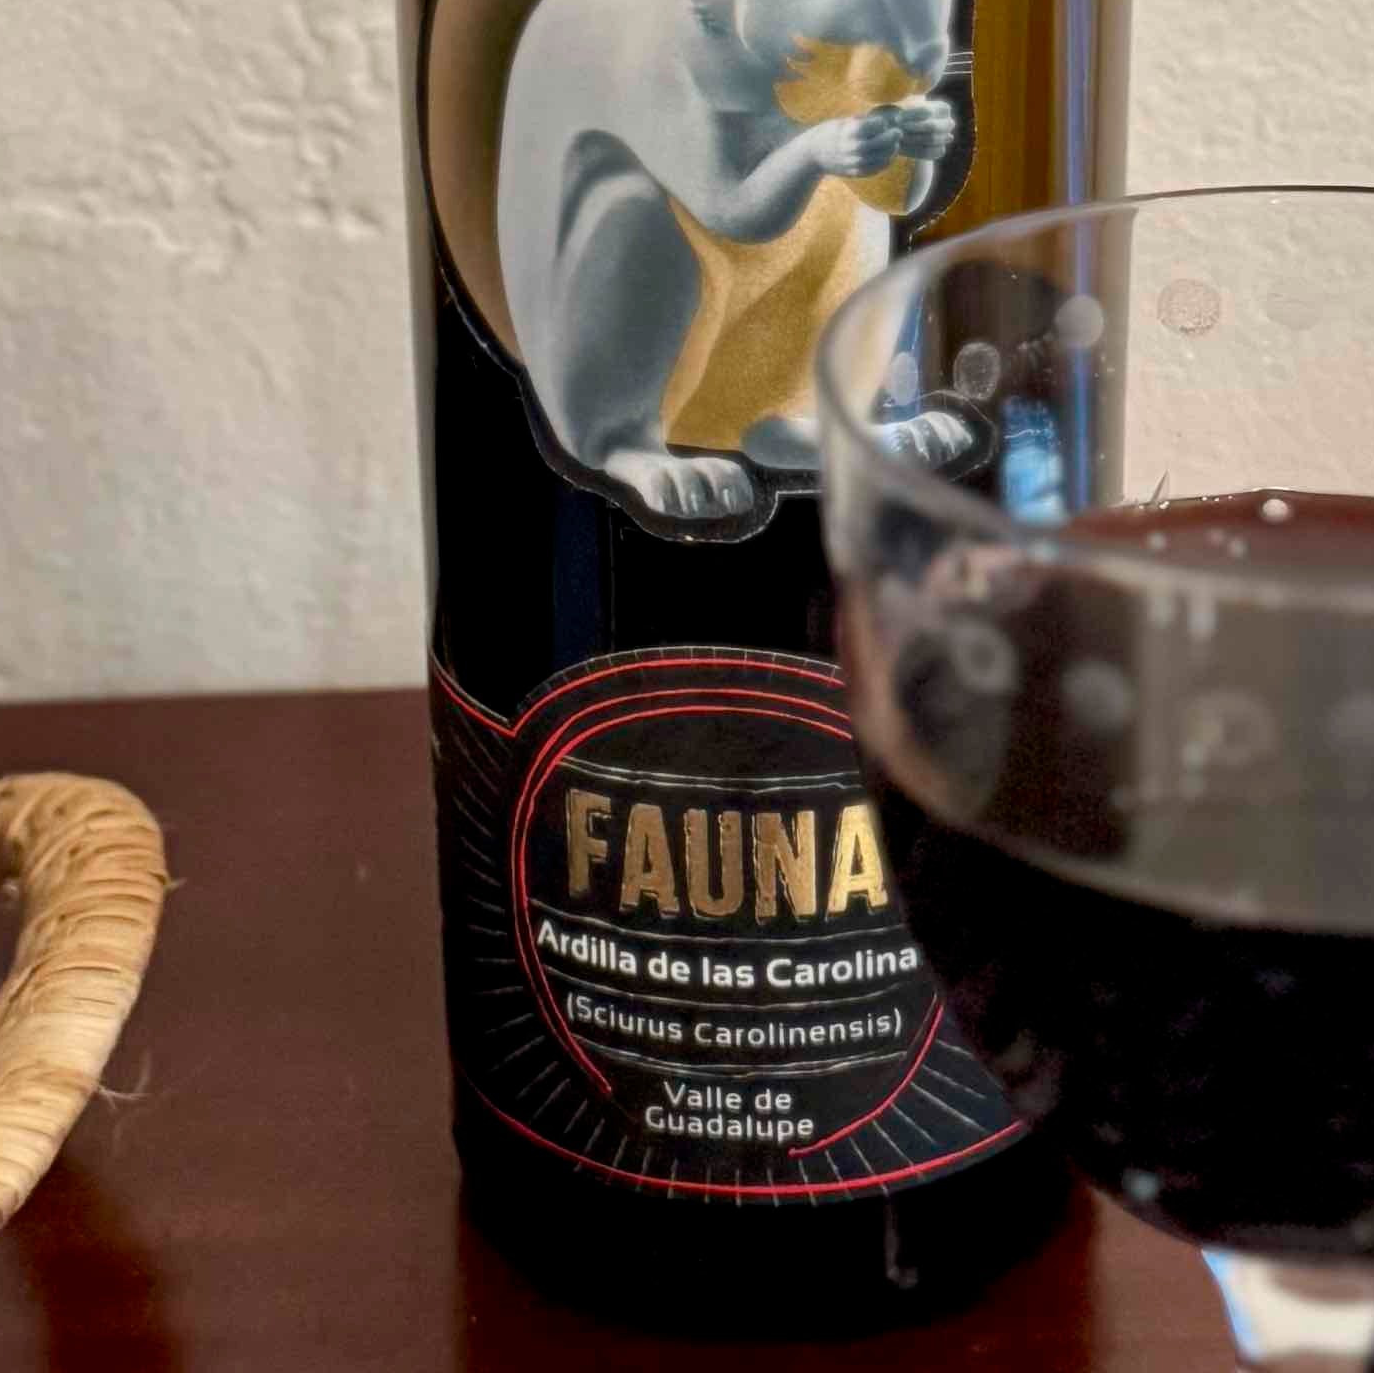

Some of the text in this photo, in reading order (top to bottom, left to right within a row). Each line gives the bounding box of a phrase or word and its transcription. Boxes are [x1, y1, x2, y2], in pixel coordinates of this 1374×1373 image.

[565, 788, 889, 926] FAUNA
[537, 920, 637, 976] Ardilla
[648, 952, 692, 984] de
[702, 956, 756, 988] las
[566, 992, 903, 1049] (Sciurus Carolinensis)
[645, 1106, 815, 1143] Guadalupe
[664, 1081, 793, 1111] Valle de
